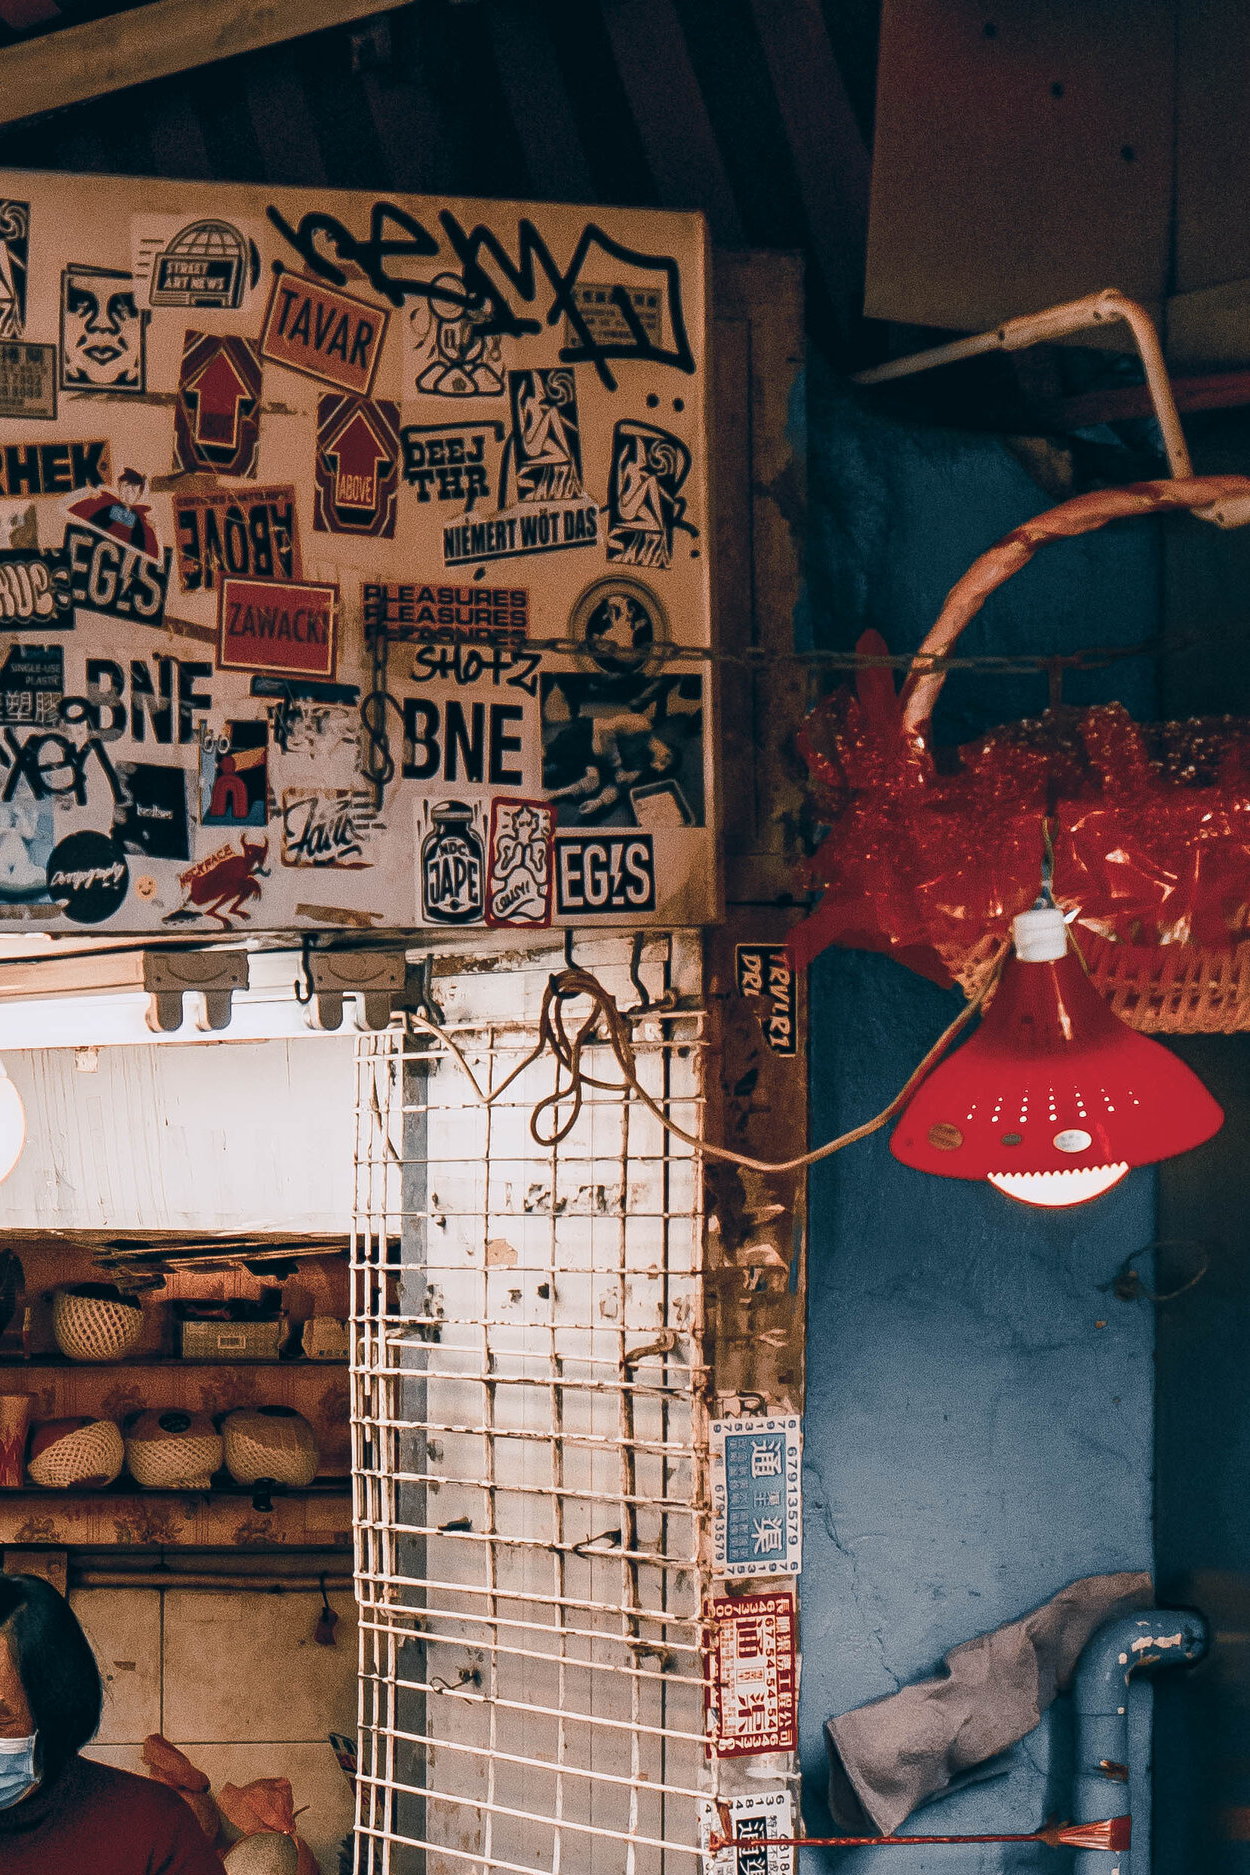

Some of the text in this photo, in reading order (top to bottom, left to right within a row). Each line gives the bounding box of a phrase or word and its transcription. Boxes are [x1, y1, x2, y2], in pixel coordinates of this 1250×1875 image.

[275, 288, 377, 370] TAVAR
[564, 507, 597, 541] DAS
[365, 583, 526, 607] PLEASURES
[365, 606, 526, 629] PLEASURES
[86, 656, 214, 745] BNE
[406, 699, 524, 785] BNE
[429, 859, 480, 905] JAPE
[751, 1440, 782, 1479] 通
[787, 1446, 798, 1547] 67913579
[751, 1517, 783, 1554] 渠
[716, 1561, 799, 1577] 6791357
[736, 1618, 764, 1660] 通
[737, 1692, 766, 1734] 渠
